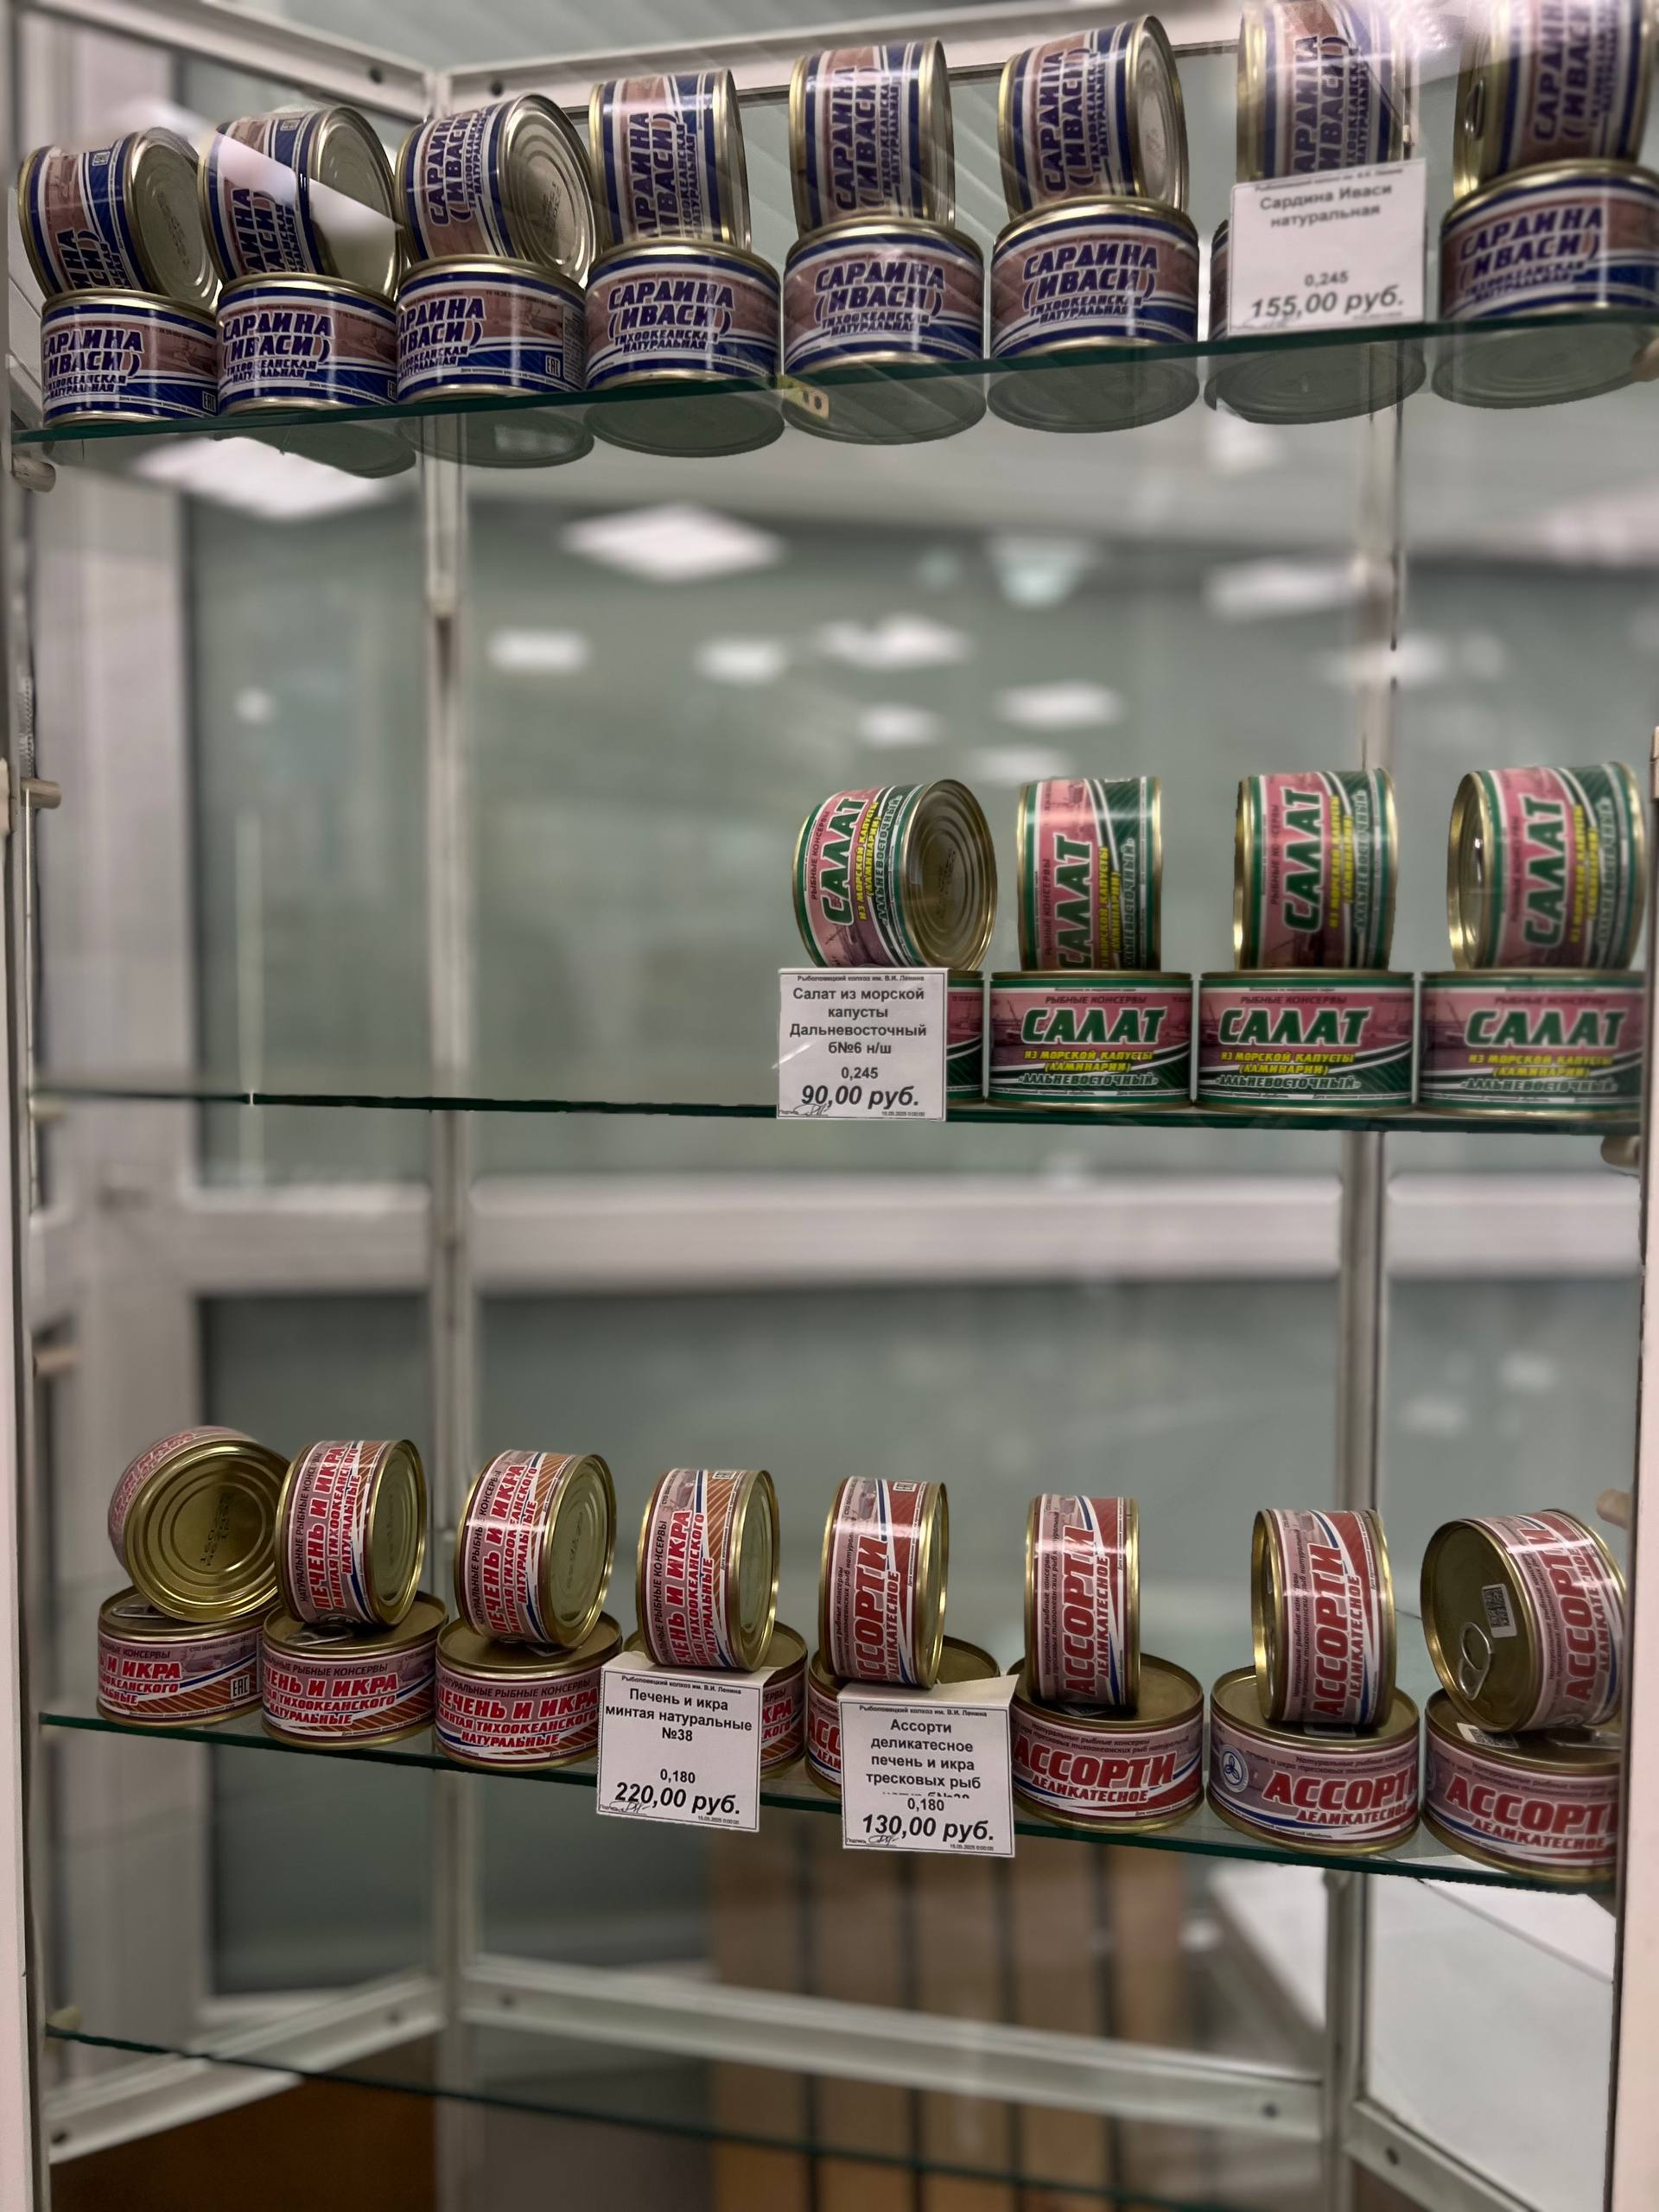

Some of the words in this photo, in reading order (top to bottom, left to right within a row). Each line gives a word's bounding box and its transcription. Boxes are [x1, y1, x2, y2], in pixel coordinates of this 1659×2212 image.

[1294, 36, 1317, 171] АРДИНА
[428, 117, 457, 225] САРДИН
[445, 116, 472, 221] (ИВАСИ
[1260, 191, 1334, 210] Сардина
[1339, 184, 1392, 200] Иваси
[1270, 204, 1381, 227] натуральная
[816, 262, 945, 294] САРДИНА
[1023, 244, 1159, 281] САРДИНА
[608, 280, 734, 310] САРДИНА
[1023, 268, 1156, 310] (ИВАСИ)
[1305, 271, 1349, 288] 0,245
[399, 298, 486, 334] АРДИНА
[816, 286, 944, 323] (ИВАСИ)
[1251, 292, 1338, 319] 155,00
[1344, 284, 1404, 315] руб.
[223, 312, 334, 343] САРДИНА
[608, 304, 733, 340] (ИВАСИ)
[812, 810, 830, 856] КОНСЕРВЫ
[820, 797, 868, 926] САЛАТ
[855, 846, 865, 902] МОРСКОЙ
[1281, 787, 1323, 933] САЛАТ
[1521, 793, 1566, 947] САЛАТ
[810, 858, 819, 900] РЫБНЫЕ
[1053, 833, 1093, 969] САЛАТ
[792, 988, 836, 1001] Салат
[840, 990, 856, 1000] из
[861, 988, 925, 1002] морской
[1045, 995, 1089, 1005] РЫБНЫЕ
[1090, 995, 1147, 1005] КОНСЕРВЫ
[1240, 995, 1283, 1005] РЫБНЫЕ
[1286, 995, 1348, 1005] КОНСЕРВЫ
[790, 1021, 927, 1038] Дальневосточный
[828, 1007, 888, 1020] капусты
[1021, 1007, 1167, 1046] САЛАТ
[1218, 1007, 1374, 1046] САЛАТ
[1465, 1007, 1629, 1048] САЛАТ
[867, 1042, 892, 1054] н/ш
[1024, 1050, 1038, 1060] ИЗ
[1039, 1049, 1097, 1061] МОРСКОЙ
[1100, 1050, 1154, 1061] КАПУСТЫ
[1235, 1051, 1292, 1063] МОРСКОЙ
[1296, 1052, 1356, 1063] КАПУСТЫ
[841, 1067, 879, 1081] 0,245
[801, 1085, 862, 1108] 90,00
[867, 1085, 919, 1109] руб.
[313, 1446, 346, 1495] ИКРА
[308, 1497, 330, 1519] И
[480, 1470, 501, 1516] КОНСЕРВЫ
[490, 1465, 527, 1521] ИКРА
[296, 1494, 309, 1535] РЫБНЫЕ
[340, 1475, 362, 1575] НАТУРАЛЬНЫЕ
[485, 1524, 504, 1547] И
[654, 1520, 668, 1577] КОНСЕРВЫ
[665, 1509, 692, 1581] ИКРА
[307, 1522, 334, 1610] ПЕЧЕНЬ
[686, 1512, 706, 1642] ТИХООКЕАНСКОГО
[483, 1550, 511, 1633] ПЕЧЕНЬ
[654, 1580, 664, 1626] РЫБНЫЕ
[665, 1585, 684, 1607] И
[701, 1556, 715, 1655] НАТУРАЛЬНЫЕ
[836, 1605, 844, 1635] рыбные
[886, 1570, 900, 1675] ДЕЛИКАТЕСНОЕ
[1042, 1592, 1051, 1625] рыбные
[1063, 1525, 1096, 1695] АССОРТИ
[1096, 1555, 1109, 1678] ДЕЛИКАТЕСНОЕ
[1518, 1528, 1596, 1702] АССОРТИ
[1308, 1543, 1349, 1717] АССОРТИ
[1347, 1574, 1362, 1700] ДЕЛИКАТЕСНОЕ
[121, 1660, 182, 1680] ИКРА
[123, 1649, 171, 1659] КОНСЕРВЫ
[292, 1664, 332, 1677] РЫБНЫЕ
[333, 1662, 389, 1676] КОНСЕРВЫ
[307, 1679, 327, 1698] И
[332, 1673, 399, 1698] ИКРА
[494, 1688, 538, 1699] РЫБНЫЕ
[540, 1679, 591, 1697] КОНСЕРВЫ
[629, 1688, 680, 1706] Печень
[683, 1696, 692, 1707] и
[696, 1697, 728, 1713] икра
[269, 1701, 353, 1726] НАТУРАЛЬНЫЕ
[278, 1694, 397, 1713] ТИХООКЕАНСКОГО
[437, 1686, 507, 1720] ПЕЧЕНЬ
[512, 1700, 534, 1720] И
[538, 1687, 600, 1719] ИКРА
[605, 1705, 655, 1720] минтая
[658, 1712, 753, 1732] натуральные
[461, 1731, 561, 1748] НАТУРАЛЬНЫЕ
[661, 1726, 693, 1742] №38
[890, 1719, 952, 1735] Ассорти
[870, 1738, 974, 1752] деликатесное
[1014, 1734, 1178, 1789] АССОРТИ
[659, 1768, 696, 1784] 0,180
[871, 1754, 923, 1768] печень
[927, 1758, 937, 1769] и
[940, 1758, 975, 1773] икра
[866, 1772, 945, 1788] тресковых
[950, 1776, 982, 1790] рыб
[1031, 1774, 1149, 1803] ДЕЛИКАТЕСНОЕ
[614, 1782, 688, 1808] 220,00
[691, 1794, 741, 1815] руб.
[907, 1796, 945, 1812] 0,180
[862, 1813, 937, 1840] 130,00
[943, 1820, 995, 1843] руб.
[1471, 1818, 1605, 1851] ДЕЛИКАТЕСНОЕ
